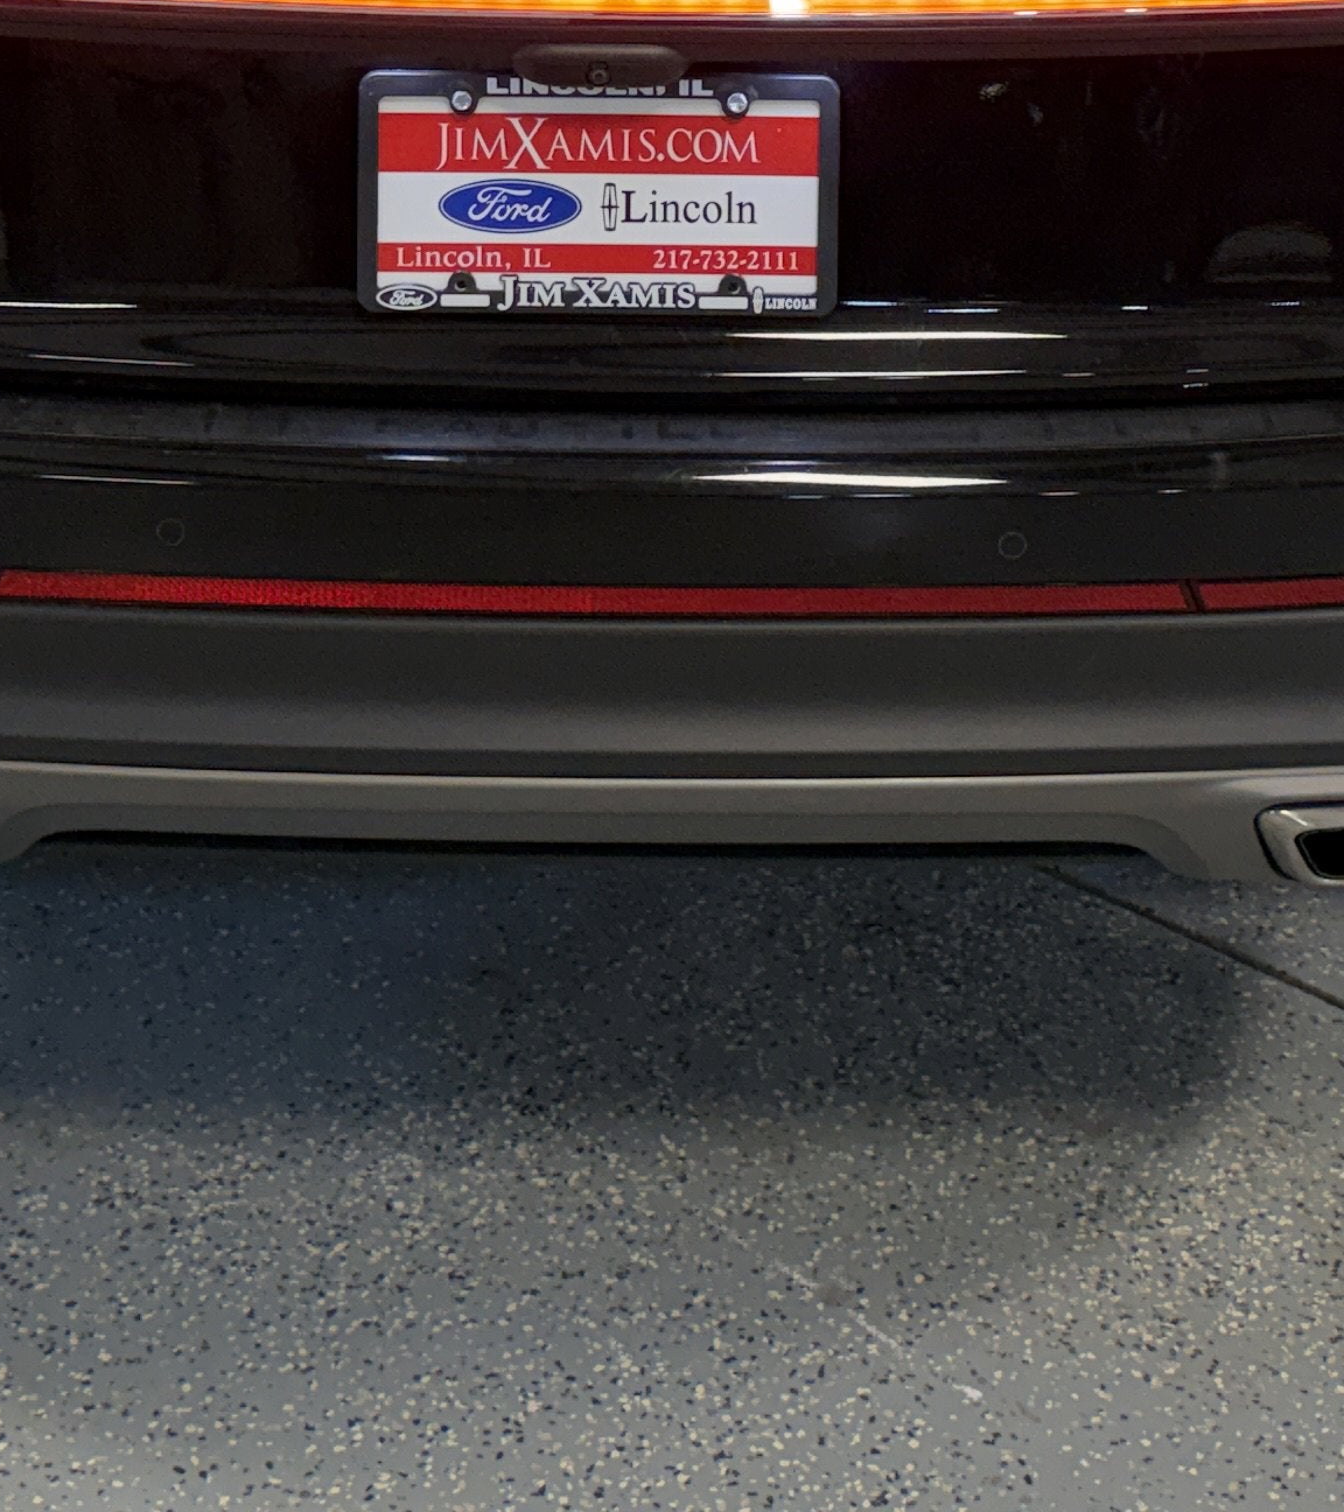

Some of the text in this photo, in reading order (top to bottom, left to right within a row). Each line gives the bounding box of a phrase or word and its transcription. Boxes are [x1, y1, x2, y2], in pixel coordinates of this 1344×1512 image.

[679, 79, 713, 96] IL
[436, 117, 761, 170] JIMXAMIS.COM
[467, 186, 758, 225] Ford Lincoln
[397, 245, 799, 272] Lincoln, IL 217-732-2111
[388, 275, 817, 311] Ford JIM XAMIS LINCOLN
